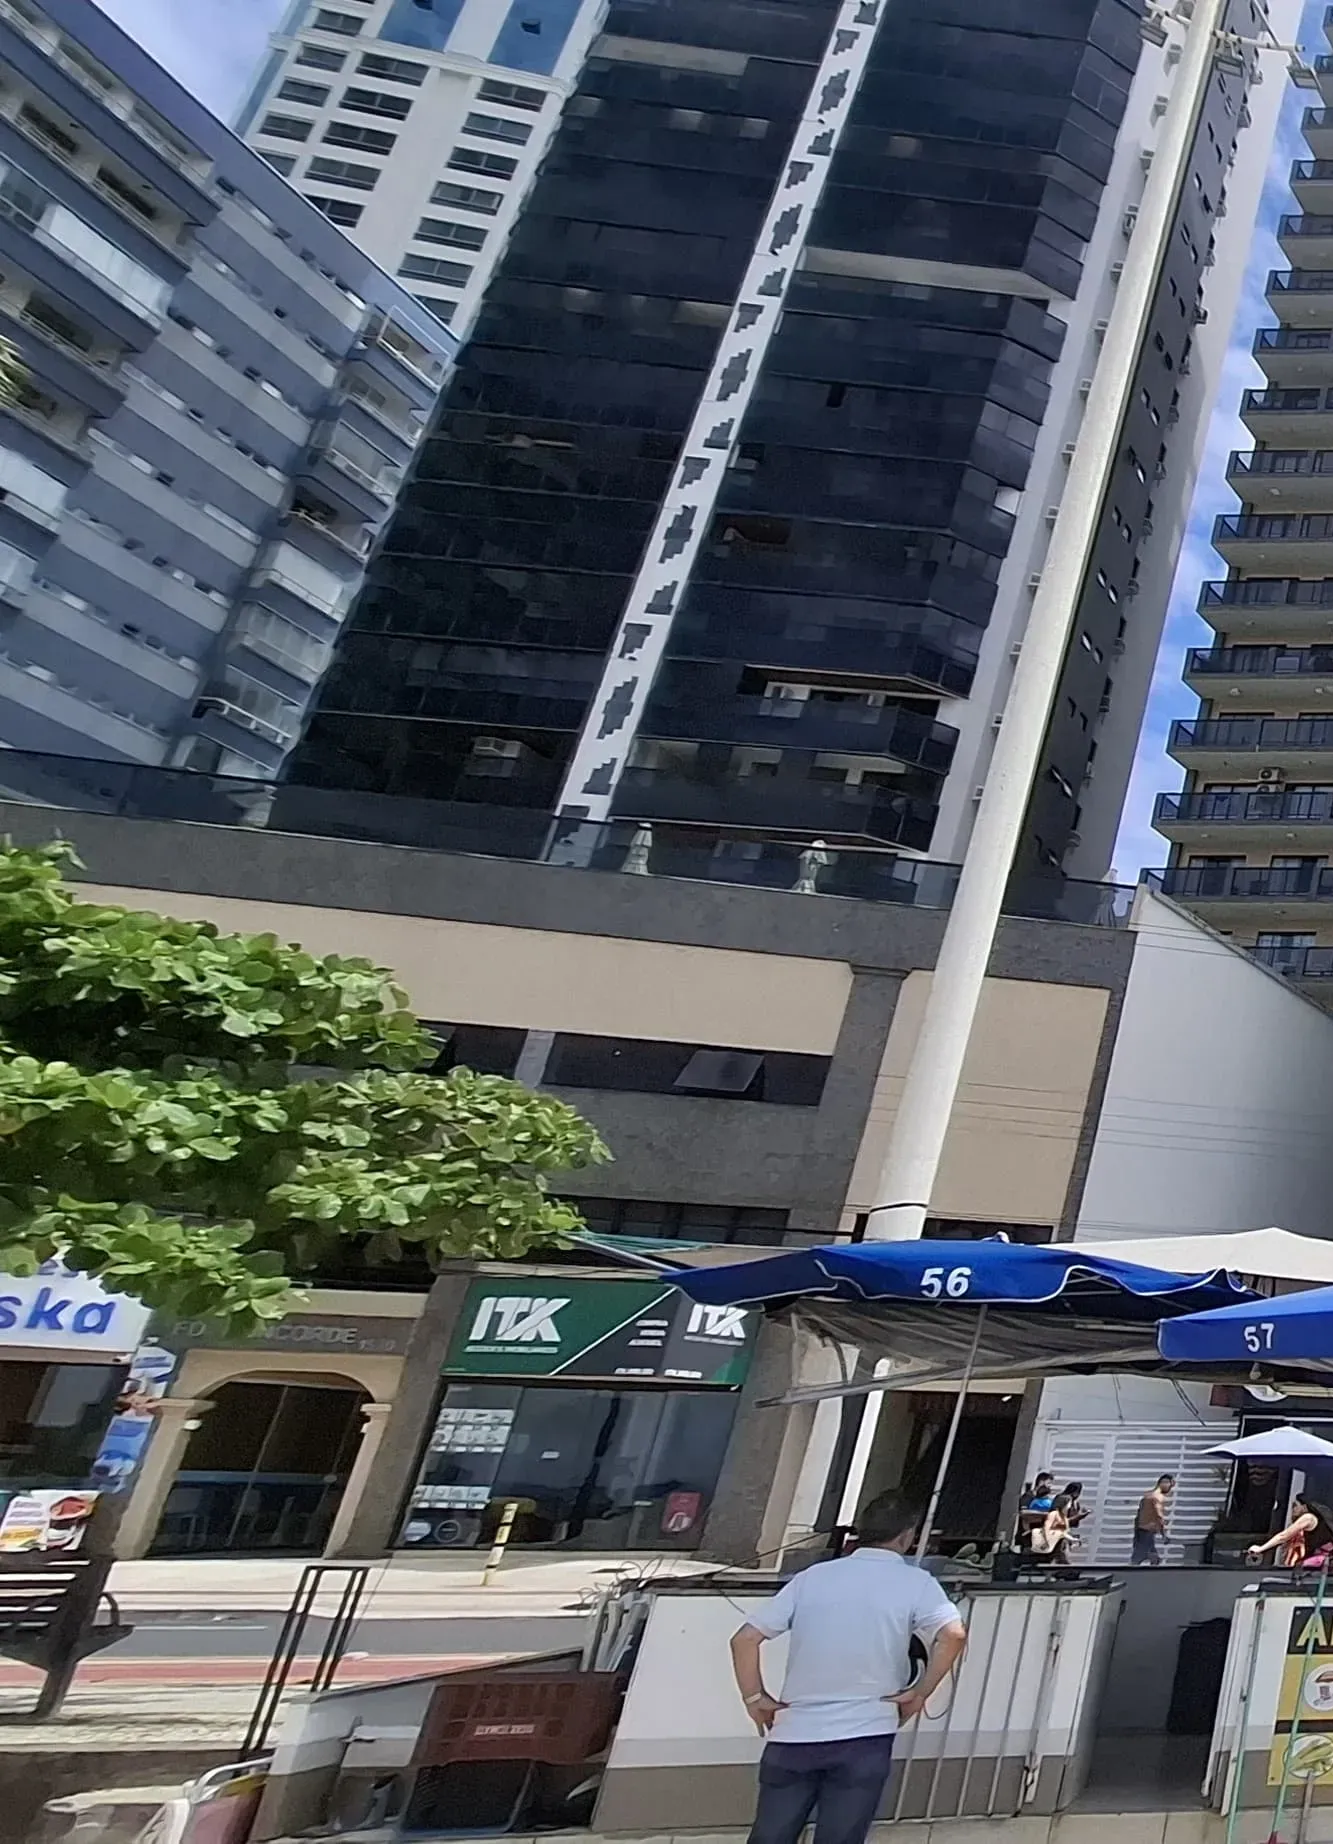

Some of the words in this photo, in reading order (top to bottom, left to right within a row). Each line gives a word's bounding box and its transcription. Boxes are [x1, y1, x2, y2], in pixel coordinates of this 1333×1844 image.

[920, 1267, 972, 1297] 56
[469, 1297, 571, 1342] ITK
[687, 1304, 748, 1338] ITK
[1244, 1323, 1274, 1352] 57
